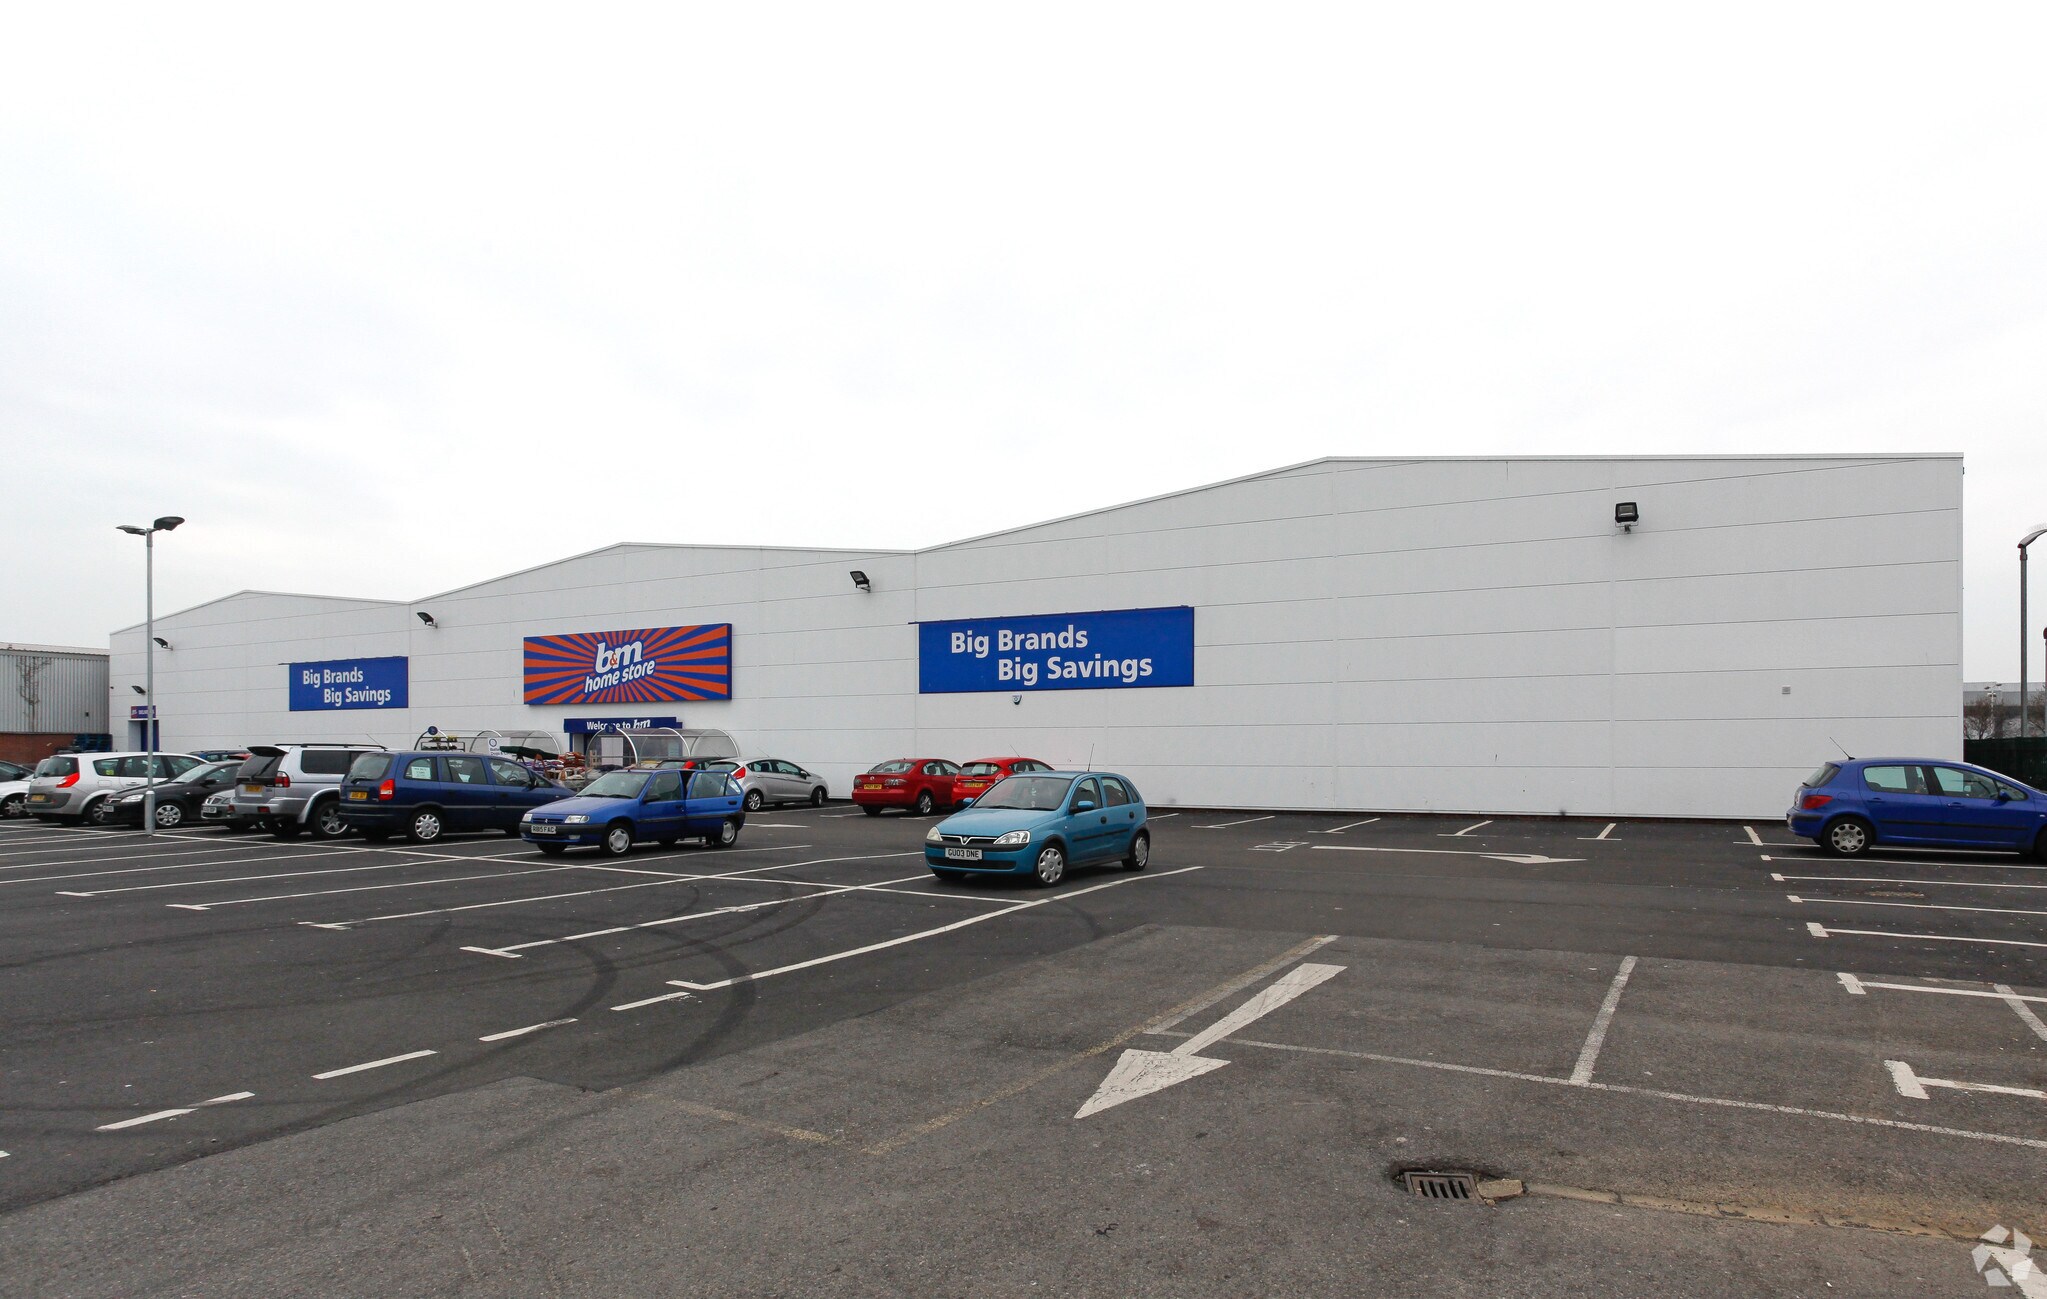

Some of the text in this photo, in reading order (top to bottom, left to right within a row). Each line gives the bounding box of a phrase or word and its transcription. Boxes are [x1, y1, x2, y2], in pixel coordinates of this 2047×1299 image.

[951, 624, 1089, 659] Big Brands
[595, 641, 642, 674] b&m
[998, 653, 1153, 686] Big Savings
[302, 666, 364, 688] Big Brands
[584, 660, 655, 693] home store
[324, 685, 391, 707] Big Savings
[586, 720, 620, 730] Welce
[622, 721, 631, 729] to
[966, 850, 980, 858] DNE
